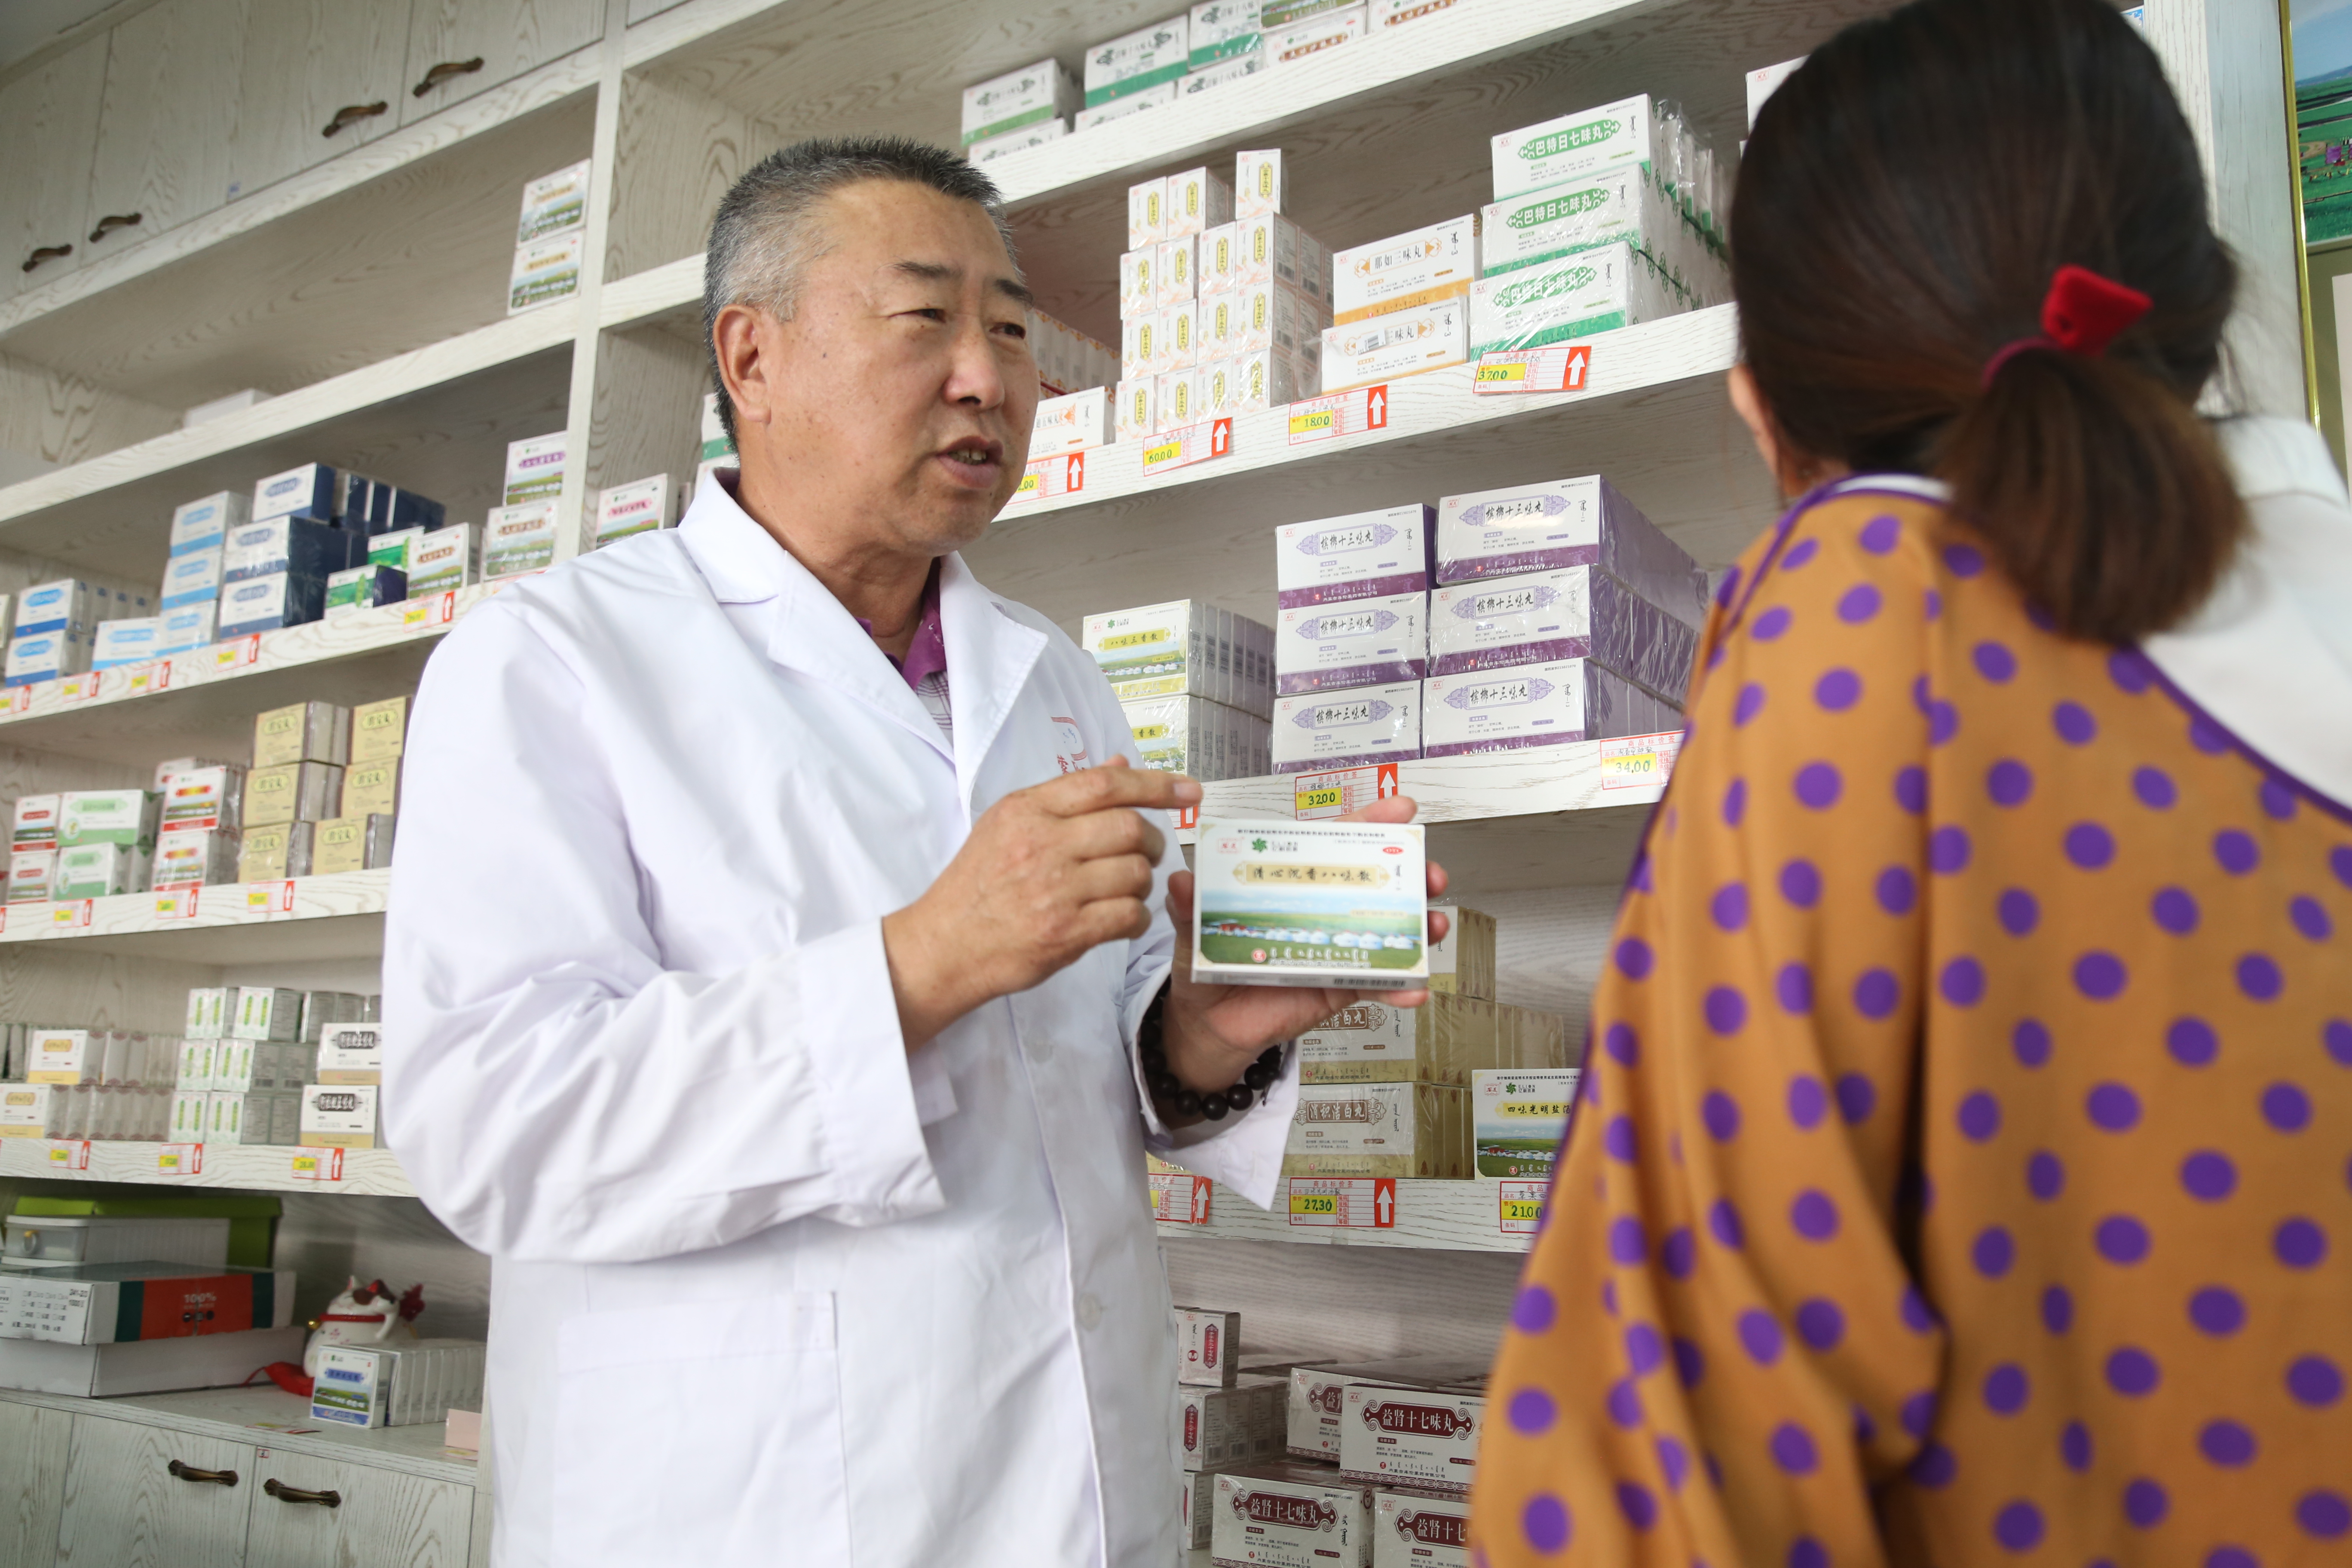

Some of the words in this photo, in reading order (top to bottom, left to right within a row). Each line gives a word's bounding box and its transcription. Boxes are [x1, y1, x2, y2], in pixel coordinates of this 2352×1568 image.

[1536, 126, 1603, 155] 巴特日七味丸
[1525, 193, 1591, 224] 巴特日七味丸
[1375, 245, 1421, 269] 那如三味丸
[1478, 370, 1508, 381] 37.00
[1311, 395, 1349, 407] 商品标价签
[1305, 416, 1329, 427] 18.00
[1149, 449, 1172, 463] 60.00
[1485, 500, 1544, 521] 槟榔十三味丸
[1320, 530, 1373, 550] 槟榔十三味丸
[1477, 592, 1534, 614] 槟榔十三味丸
[1320, 615, 1374, 635] 槟榔十三味丸
[1111, 633, 1158, 646] 八味三香散
[1321, 677, 1377, 686] 内蒙古库伦蒙药有限公司
[1470, 683, 1528, 704] 槟榔十三味丸
[1316, 705, 1369, 725] 槟榔十三味丸
[1628, 735, 1675, 746] 商品标价签
[1616, 759, 1651, 773] 34.00
[1318, 772, 1357, 783] 商品标价签
[1308, 792, 1335, 805] 32.00
[1253, 867, 1372, 882] 清心沉香八味散
[1310, 1102, 1365, 1121] 消积洁白丸
[1508, 1104, 1571, 1115] 四味光明盐汤
[1304, 1199, 1332, 1211] 27.30
[1511, 1205, 1542, 1218] 21.00
[1382, 1409, 1454, 1432] 益肾十七味丸
[1388, 1468, 1446, 1479] 内蒙古库伦蒙药有限公司
[1250, 1498, 1318, 1523] 益肾十七味丸
